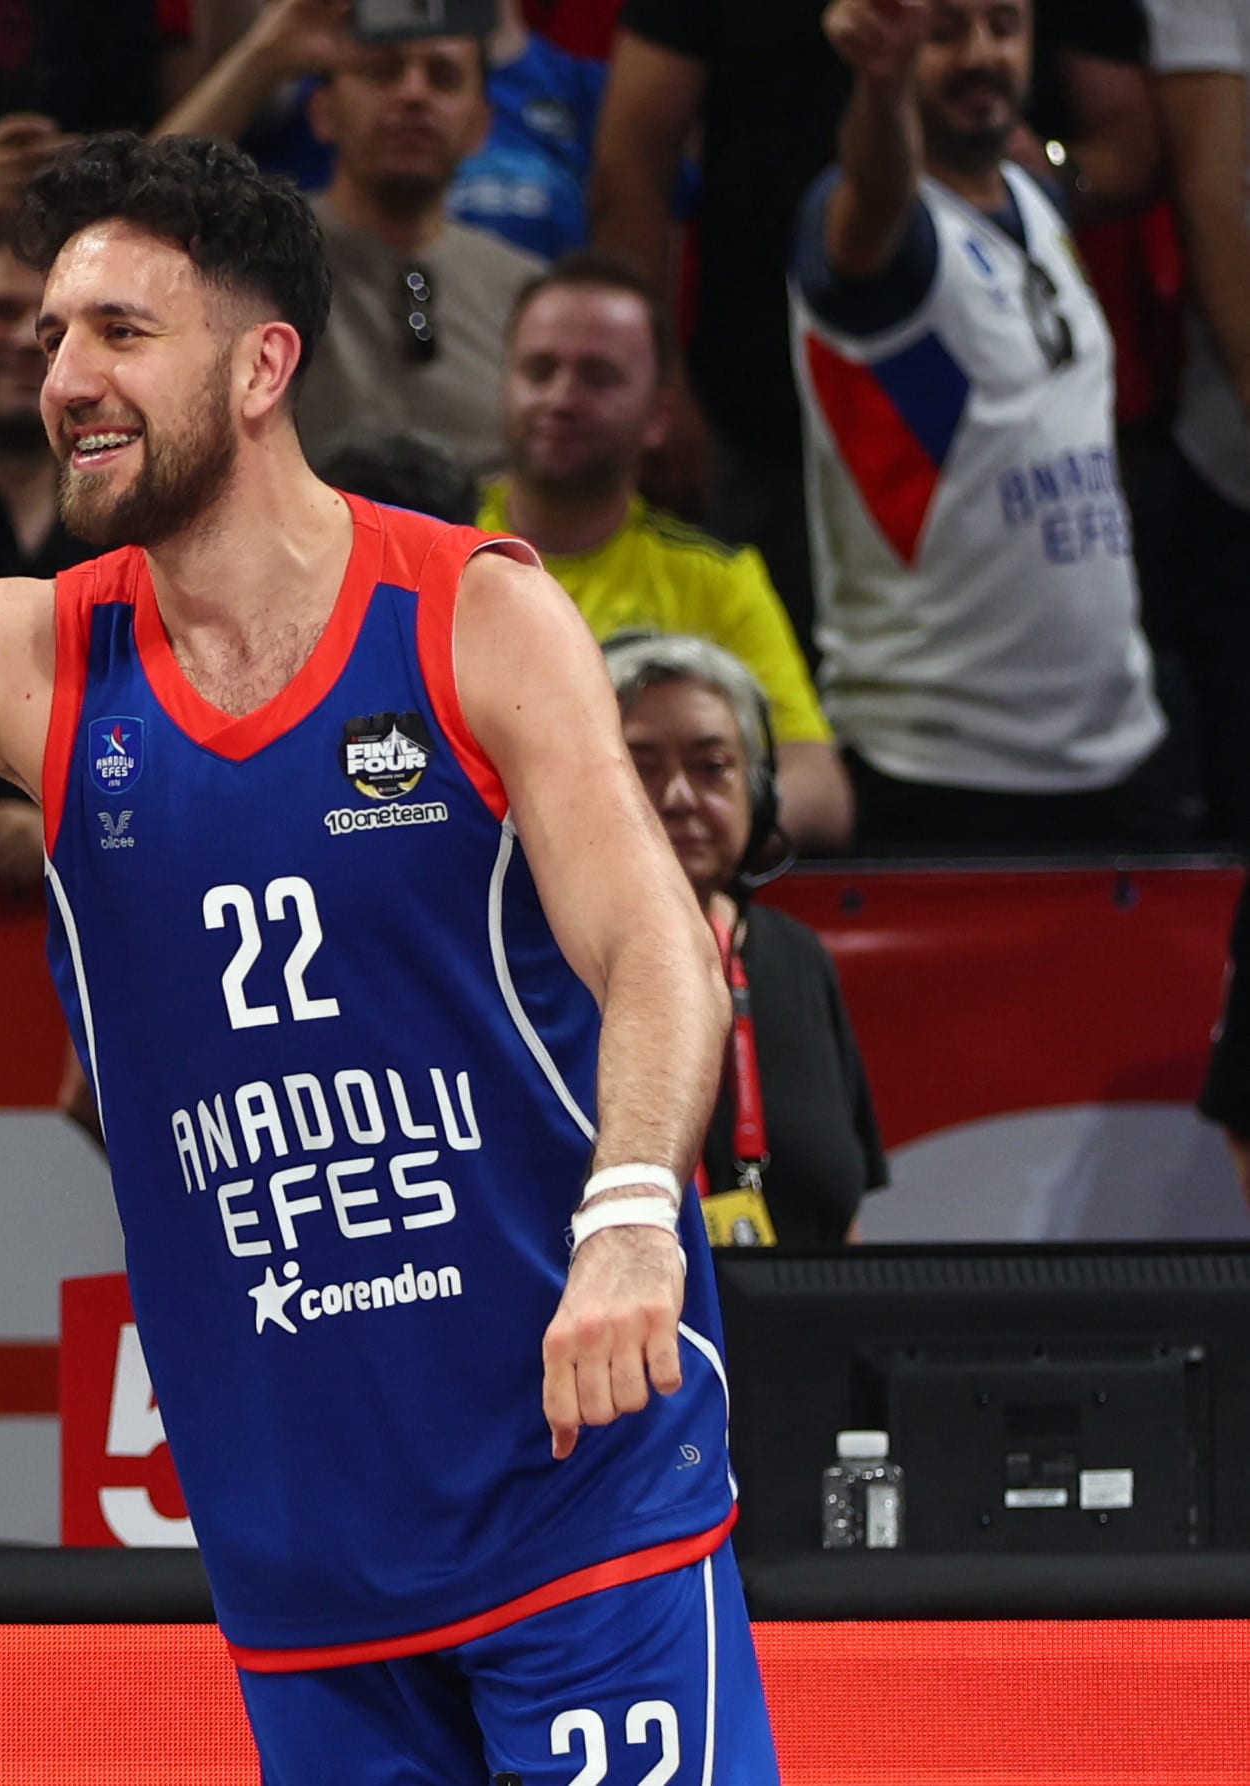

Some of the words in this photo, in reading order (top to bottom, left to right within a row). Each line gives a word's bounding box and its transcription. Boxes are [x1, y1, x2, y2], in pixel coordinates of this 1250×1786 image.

[96, 755, 134, 770] ANADOLU
[102, 767, 128, 778] EFES
[347, 752, 426, 775] FOUR
[203, 875, 341, 1030] 22
[171, 1067, 482, 1194] ANADOLU
[217, 1150, 457, 1257] EFES
[300, 1263, 463, 1321] corendon
[550, 1699, 680, 1786] 22
